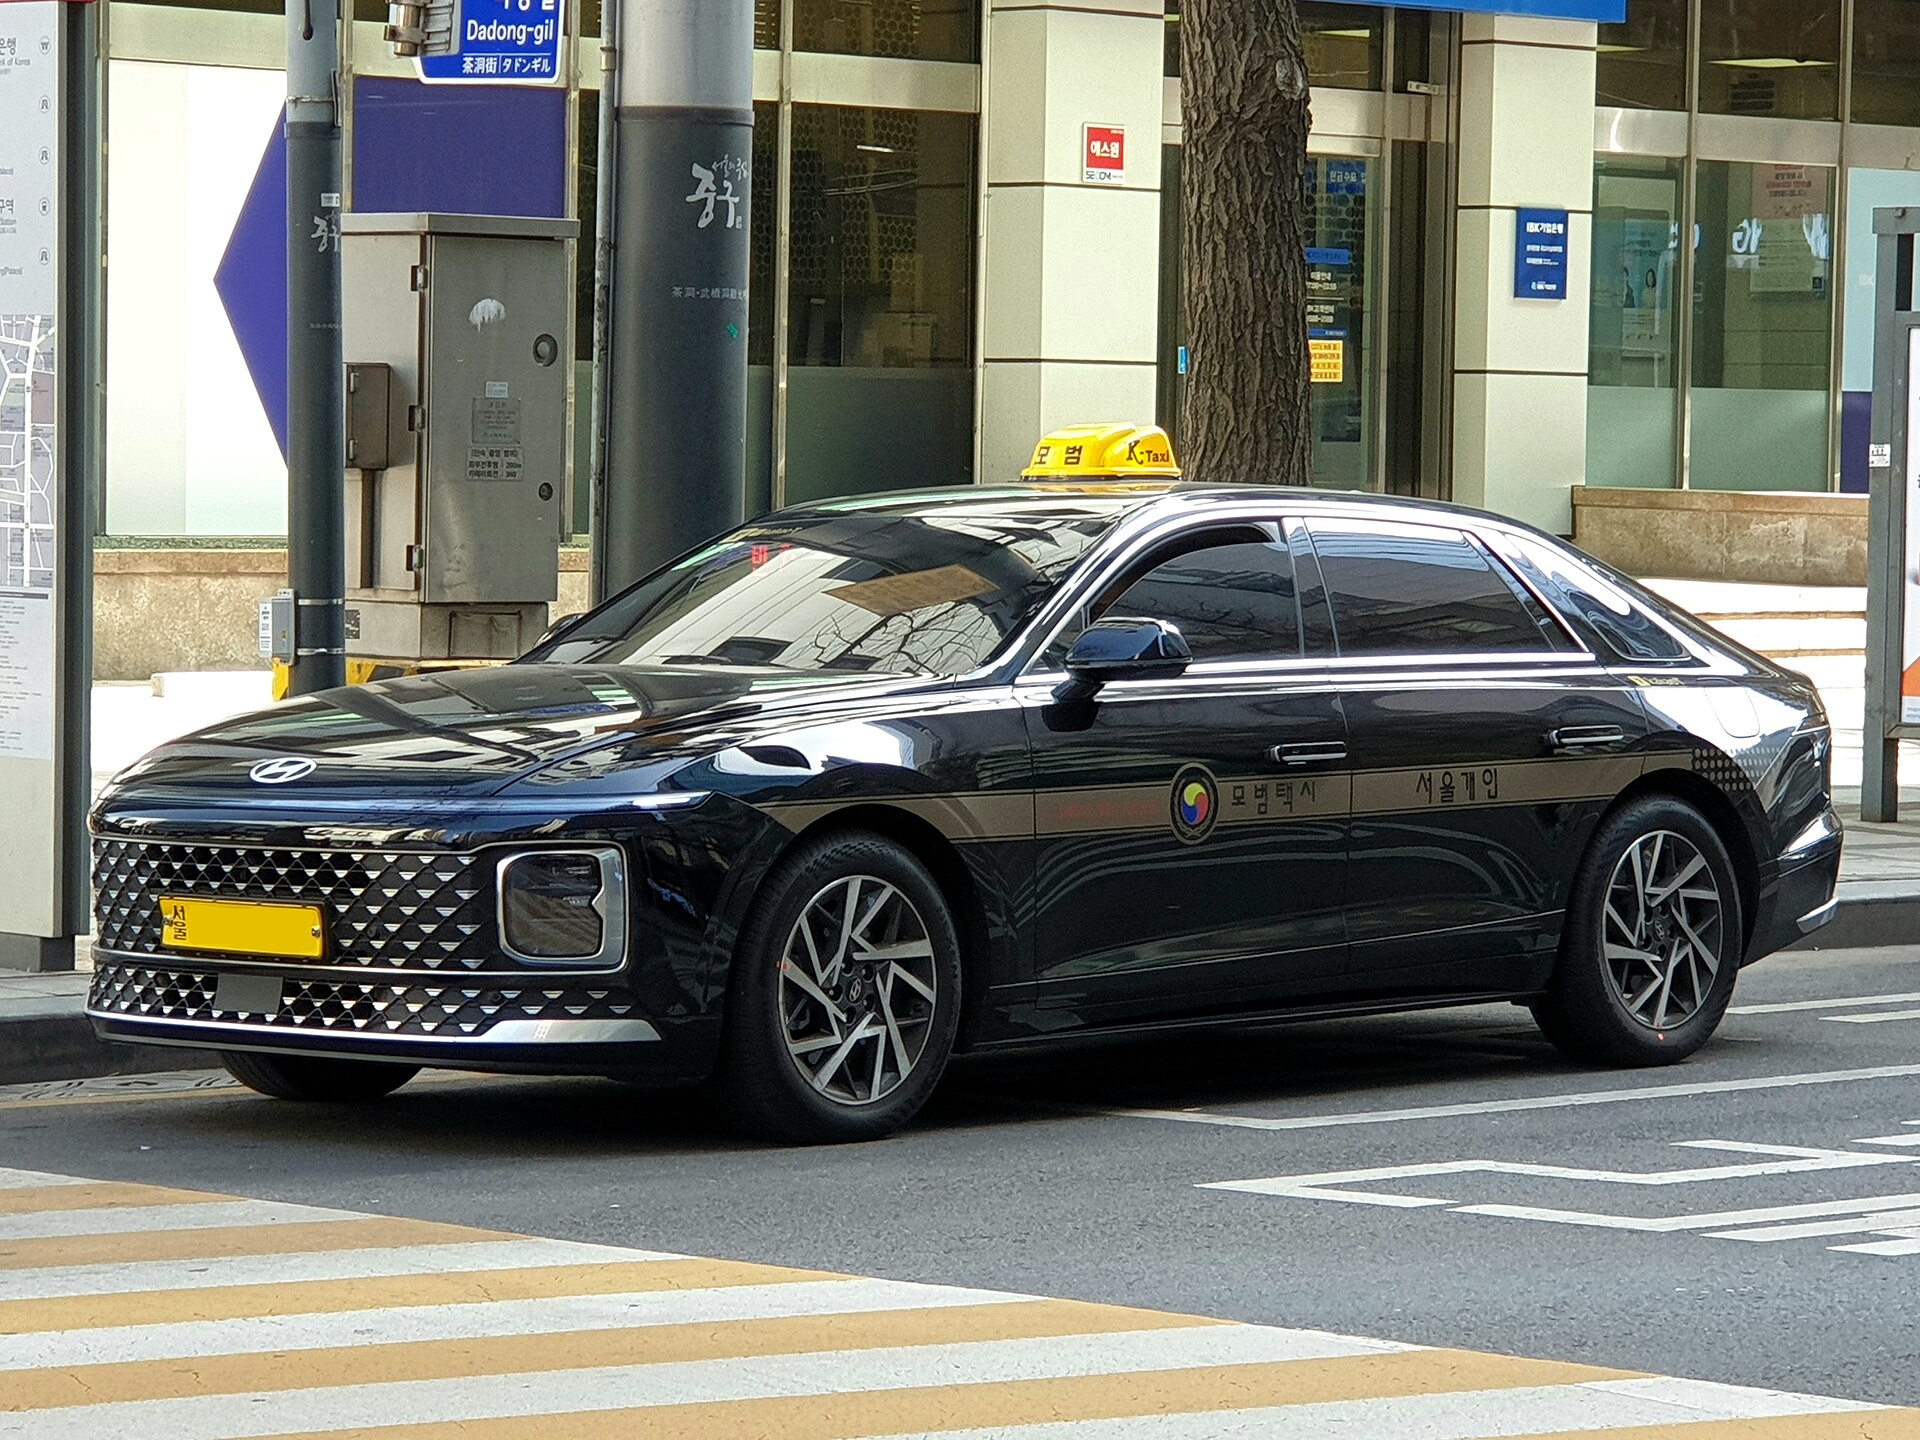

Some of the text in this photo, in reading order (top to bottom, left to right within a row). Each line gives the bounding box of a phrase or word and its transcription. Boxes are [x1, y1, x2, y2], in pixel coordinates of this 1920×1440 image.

[466, 19, 554, 46] Dadong-gil
[1090, 140, 1120, 159] 에스원
[685, 162, 741, 229] 중구
[1231, 780, 1317, 816] 모범택시
[173, 904, 188, 941] 서울
